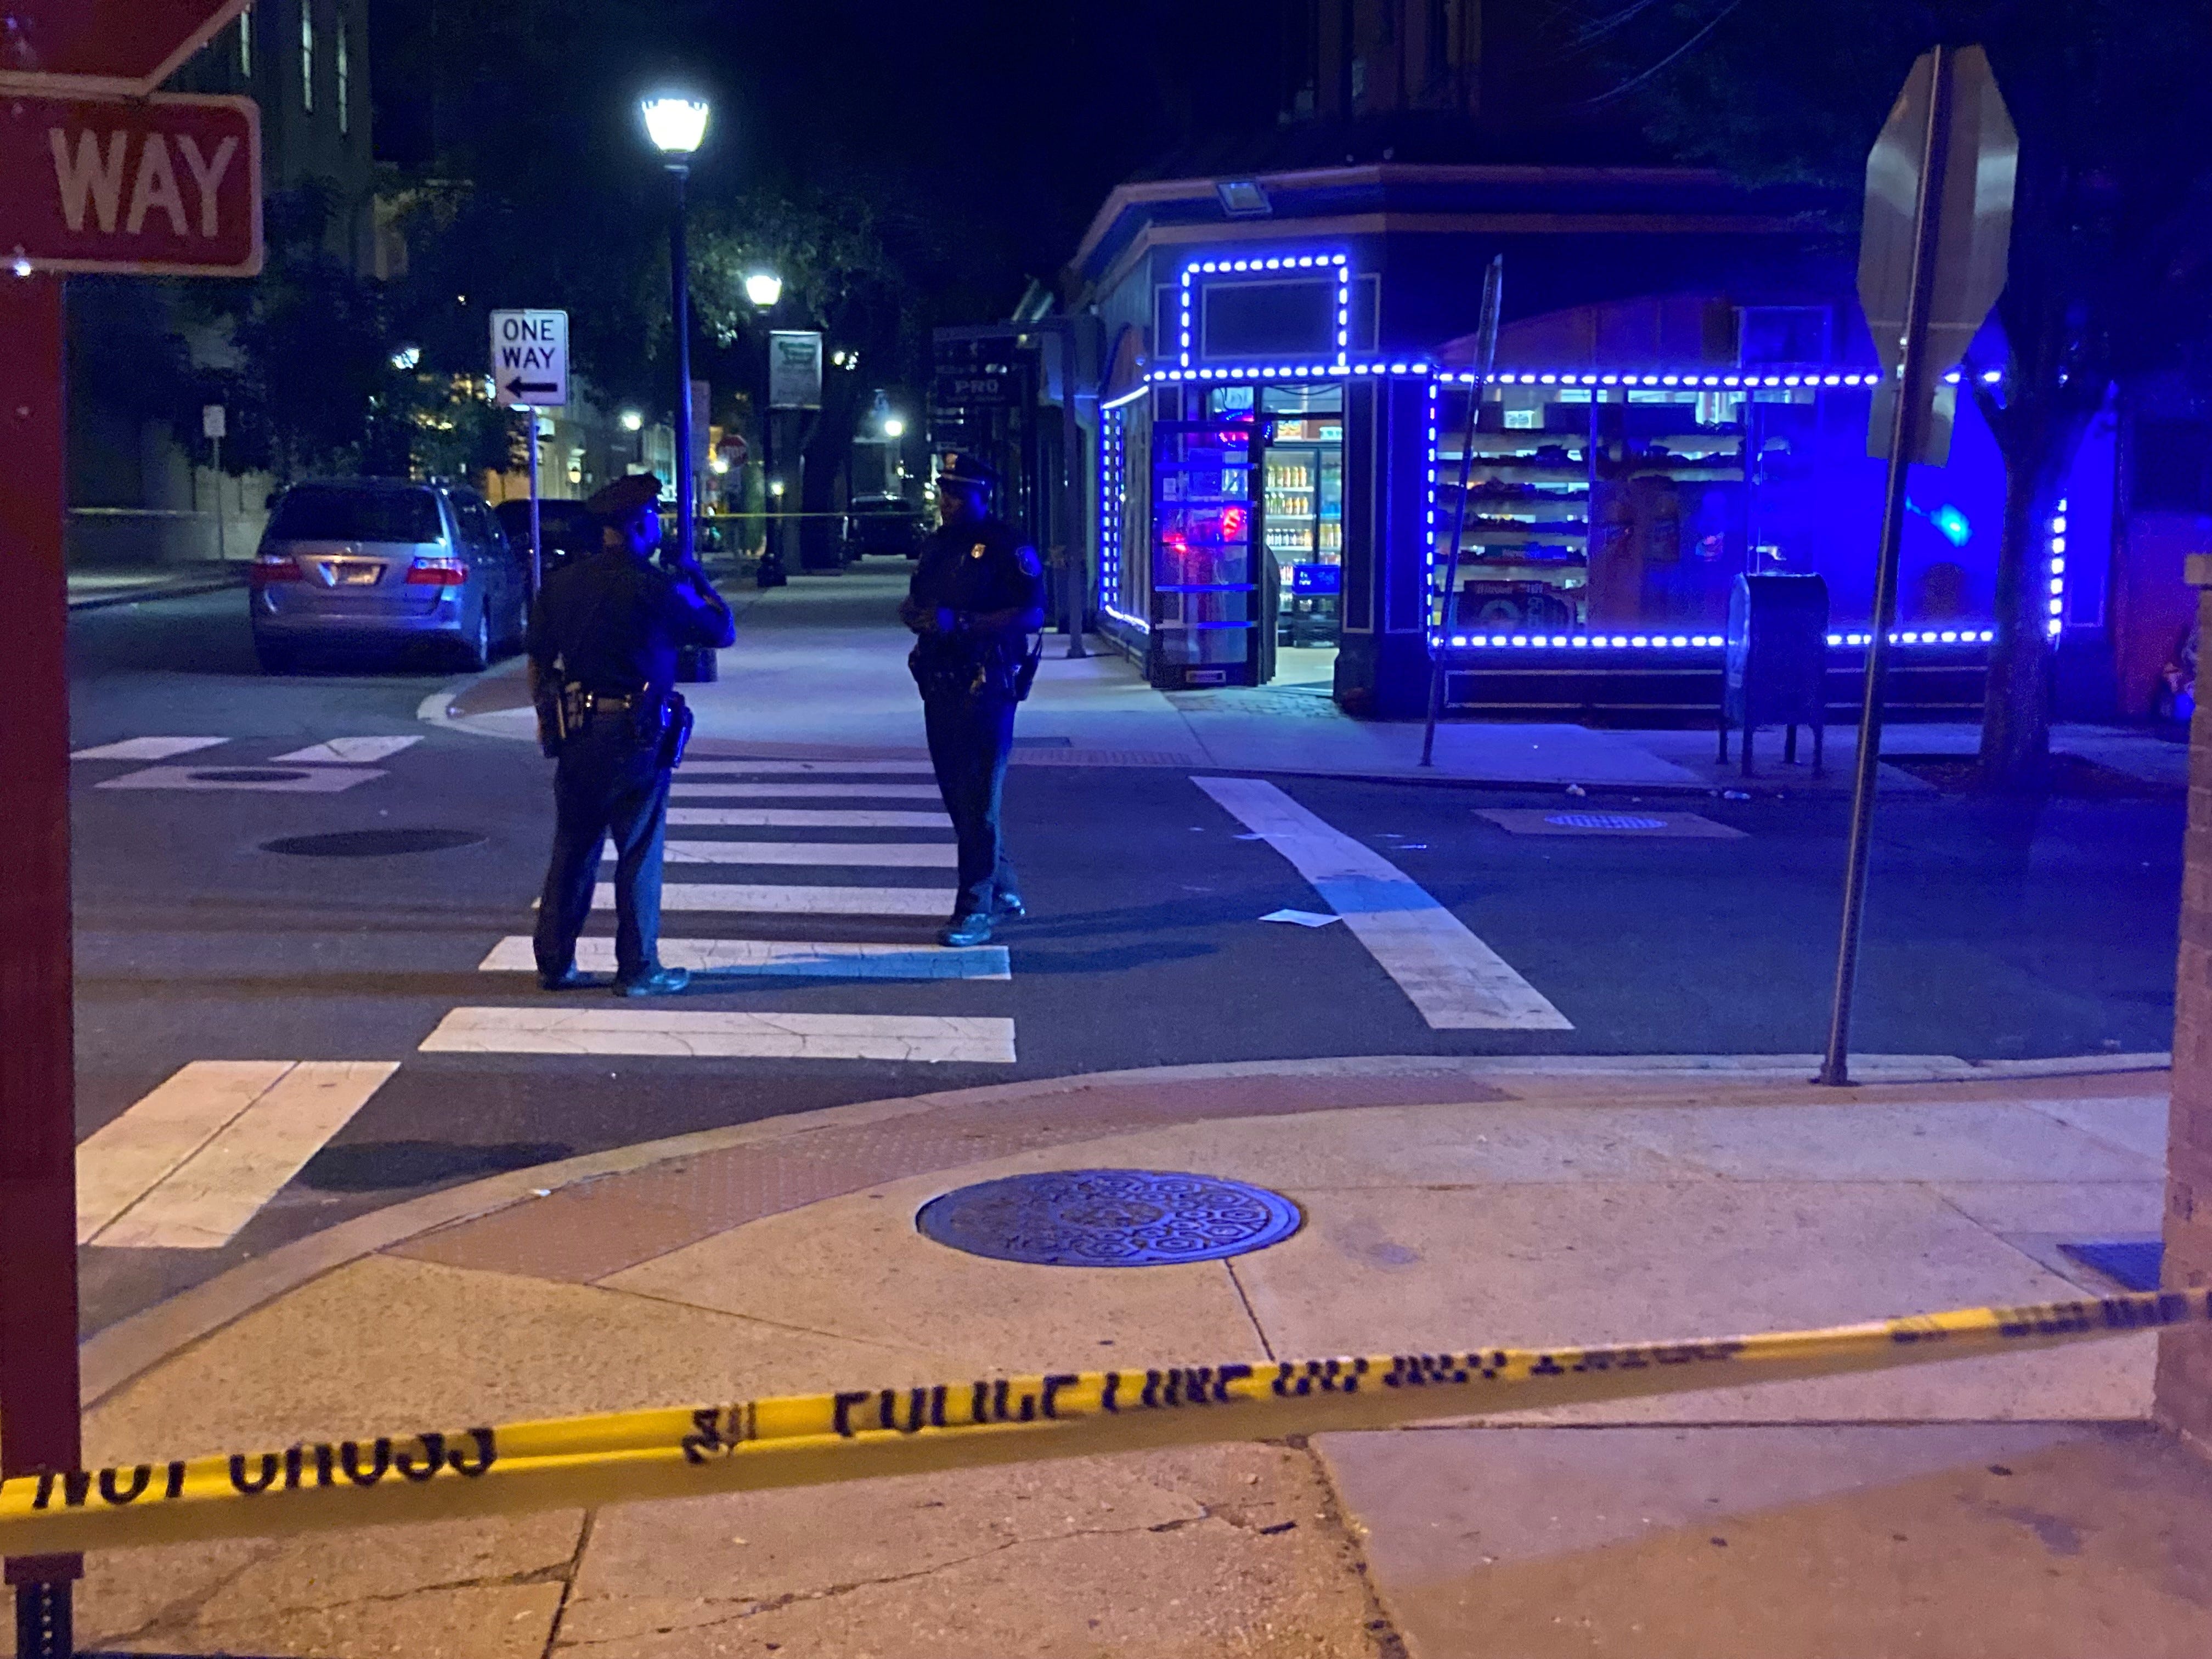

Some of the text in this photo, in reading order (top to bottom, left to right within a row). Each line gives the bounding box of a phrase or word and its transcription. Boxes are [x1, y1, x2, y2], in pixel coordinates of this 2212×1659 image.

[48, 127, 240, 238] WAY
[503, 318, 555, 341] ONE
[501, 346, 556, 369] WAY
